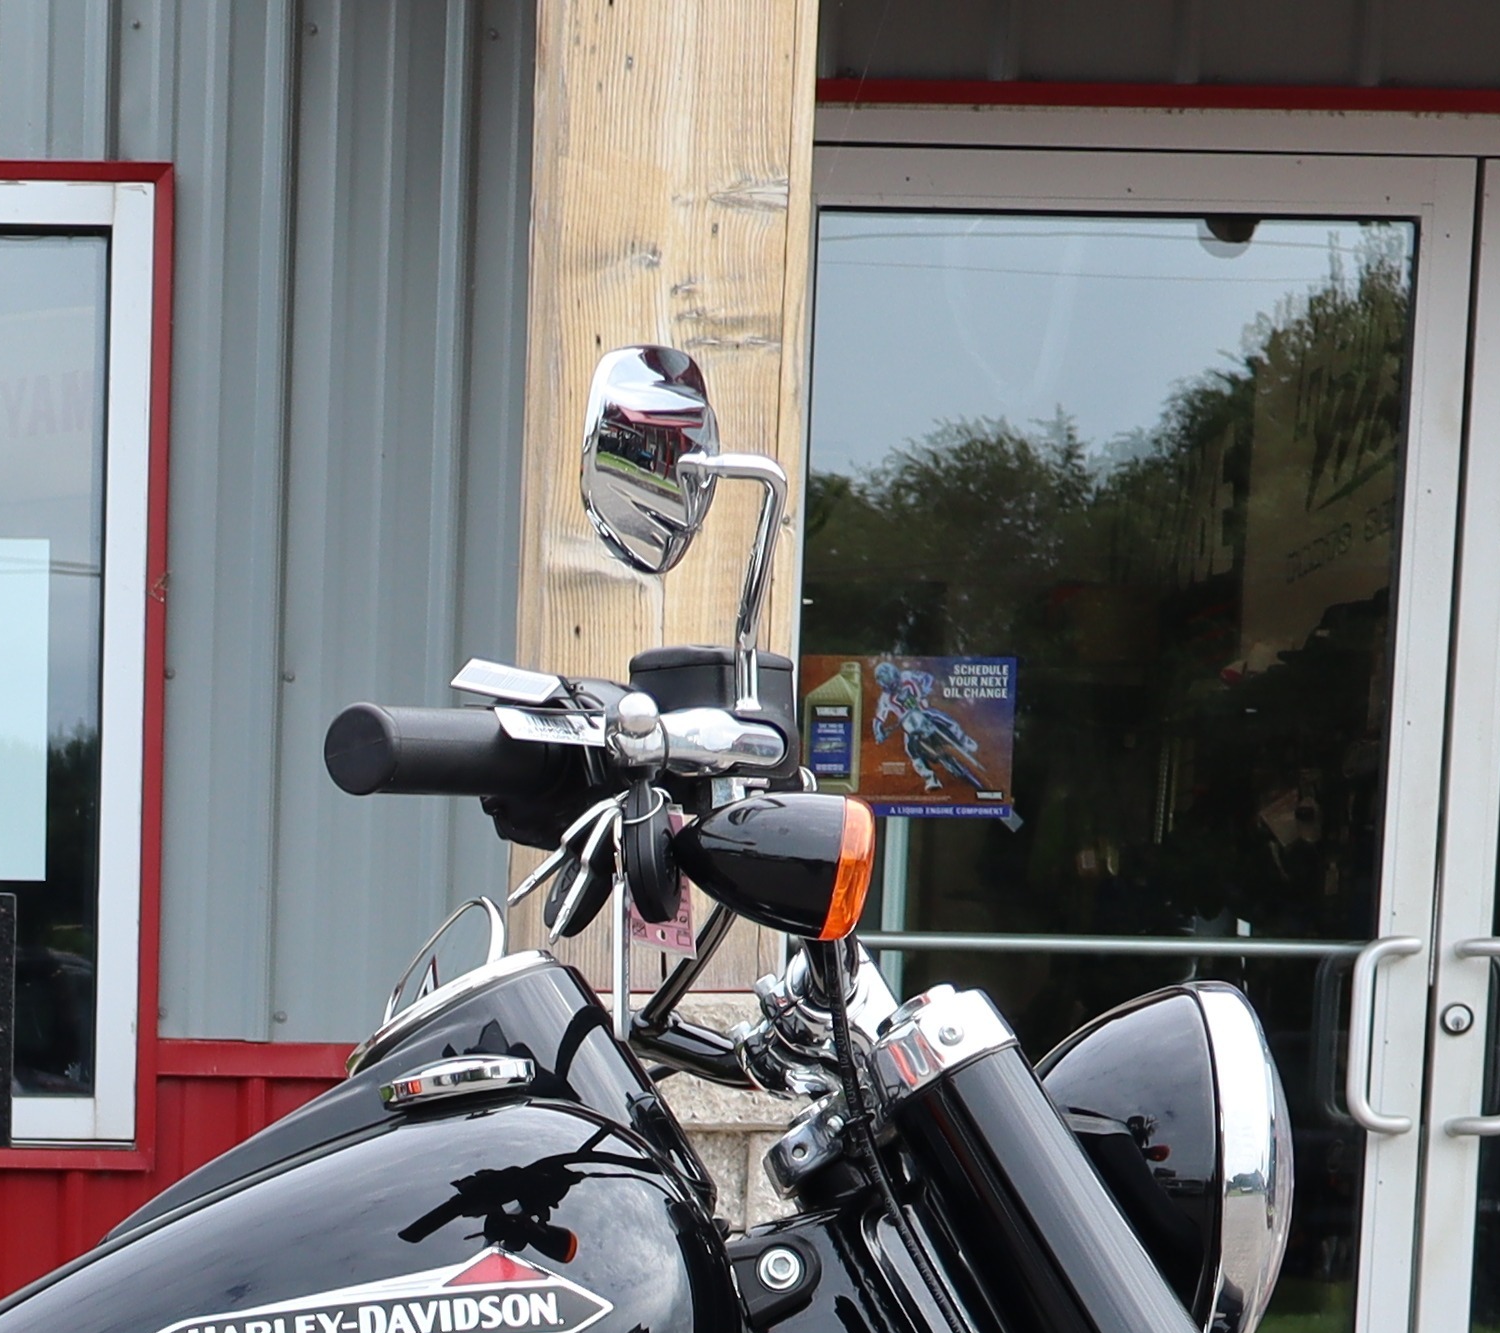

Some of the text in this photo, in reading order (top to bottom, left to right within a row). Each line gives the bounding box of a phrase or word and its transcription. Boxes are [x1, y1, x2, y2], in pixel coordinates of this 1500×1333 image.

[954, 665, 1009, 675] SCHEDULE
[949, 676, 1008, 687] YOUR NEXT
[944, 688, 1008, 698] OIL CHANGE
[957, 807, 1003, 815] COMPONENT
